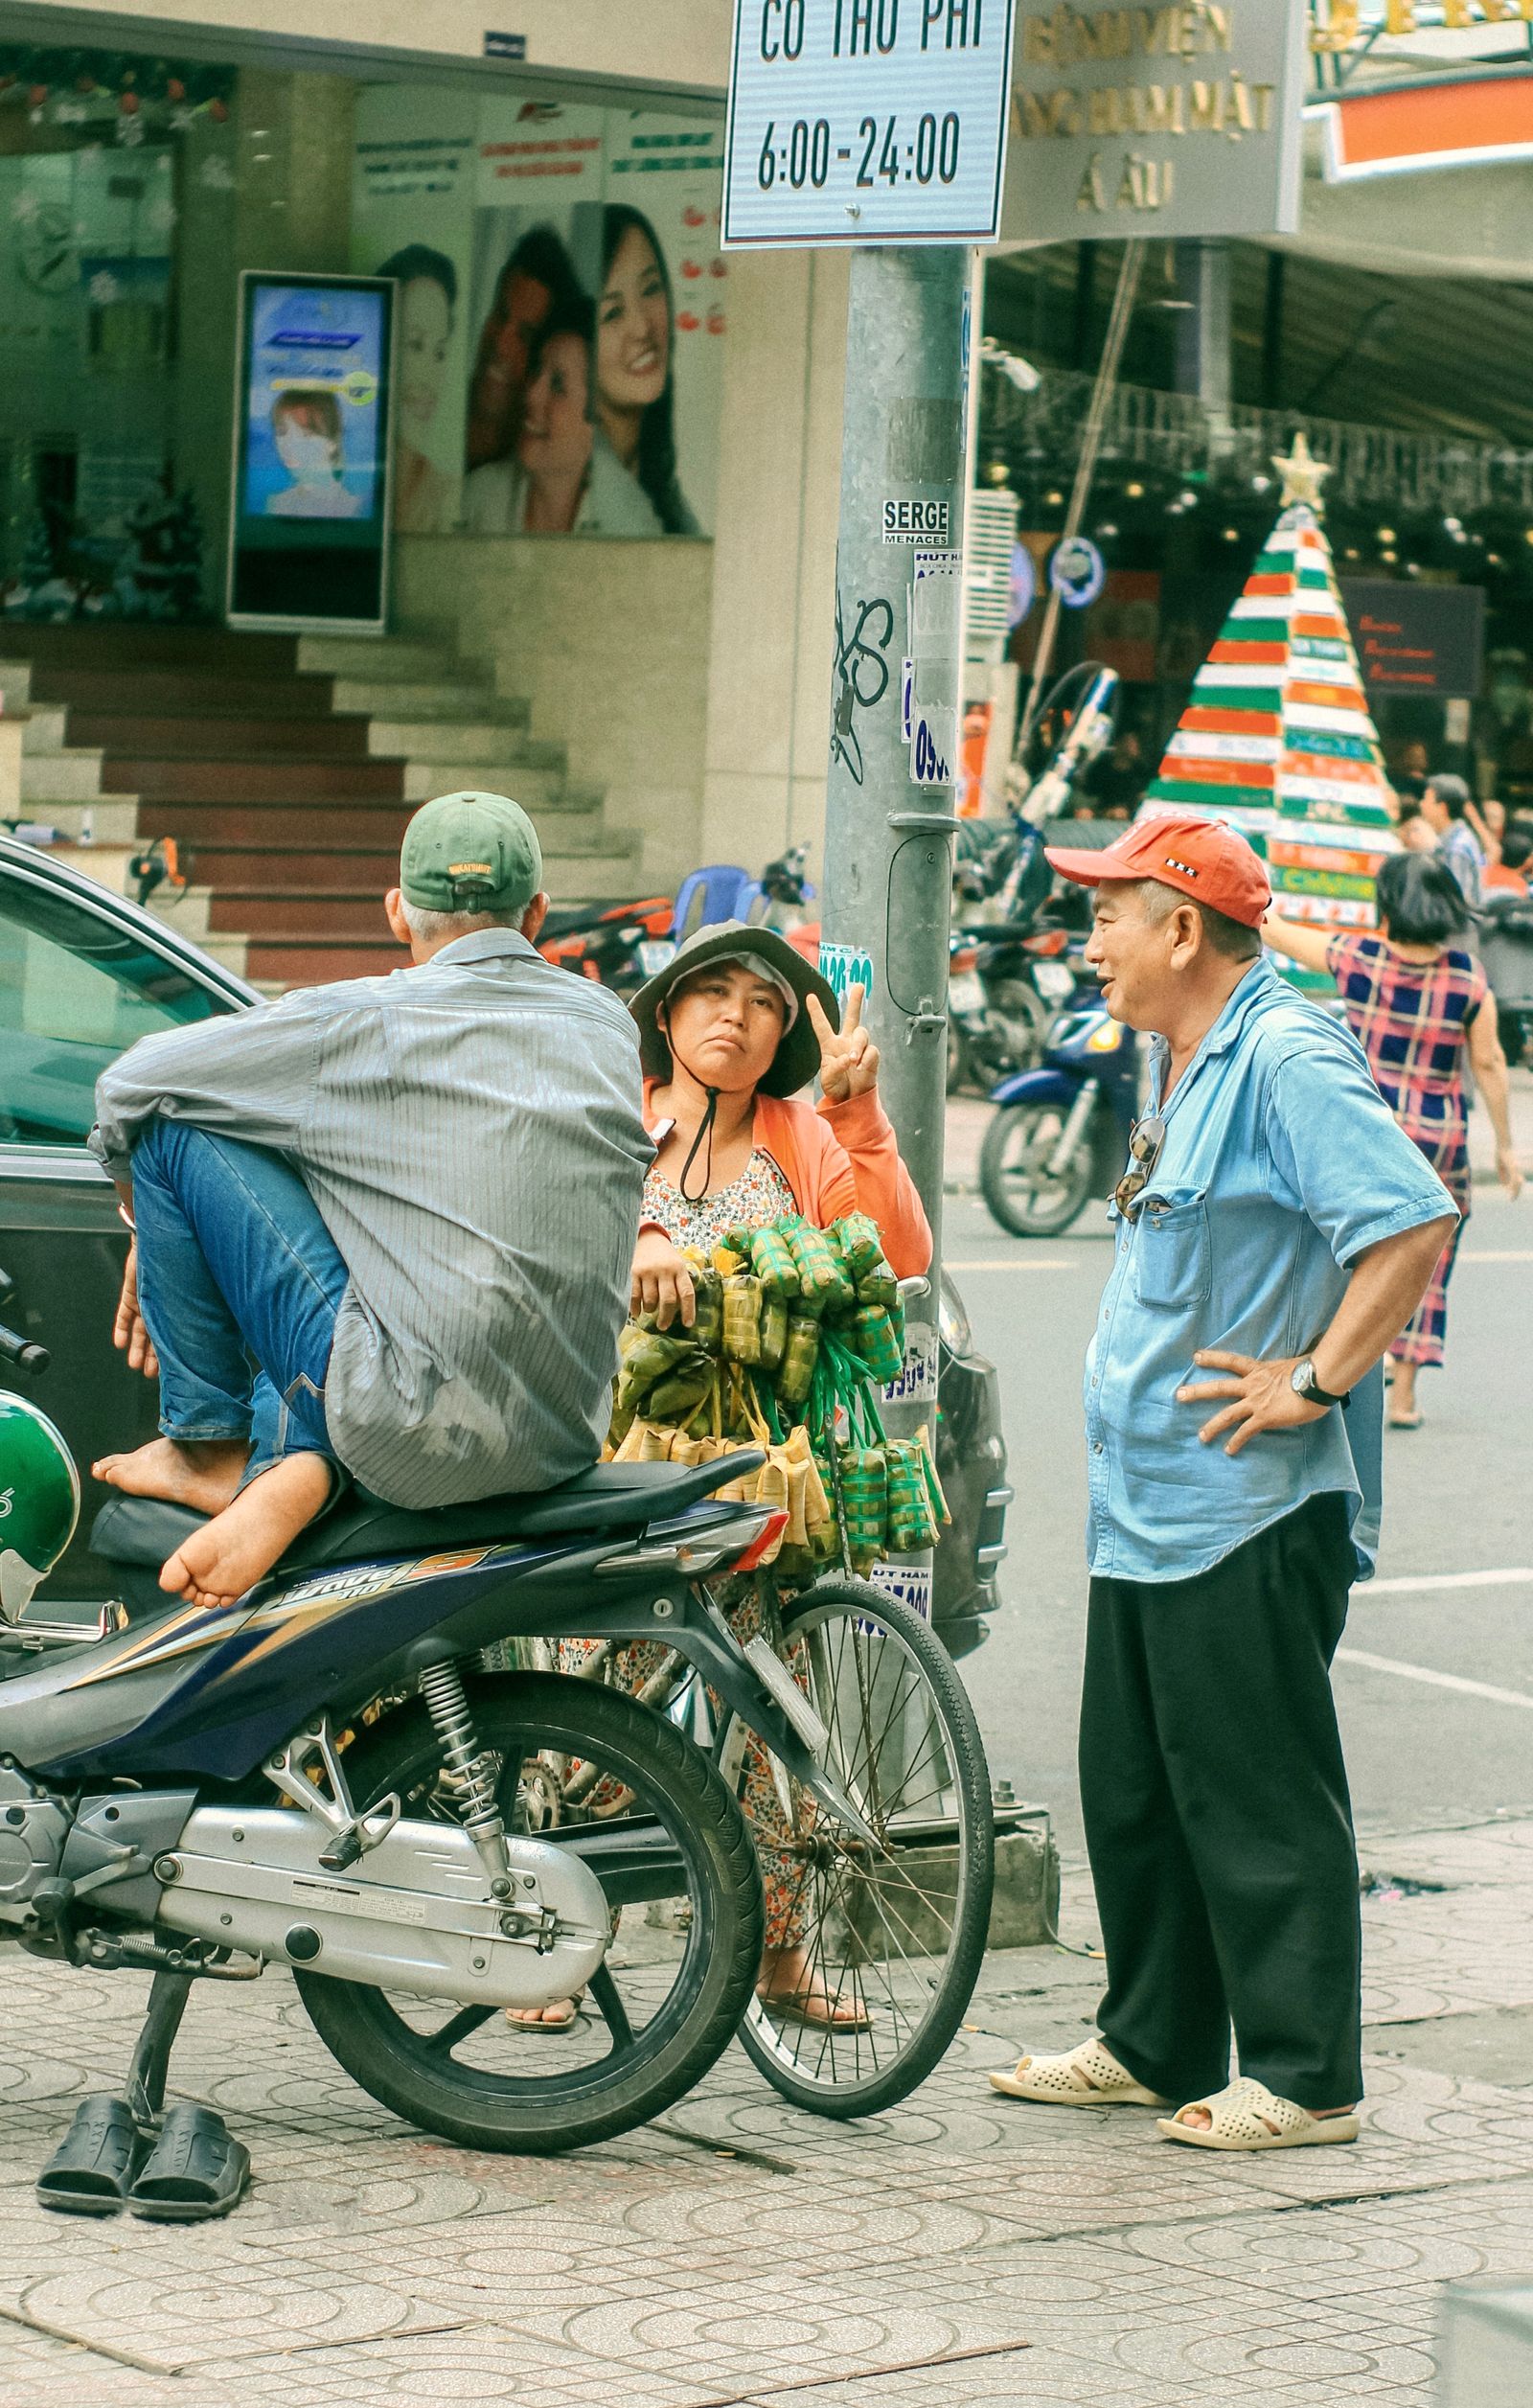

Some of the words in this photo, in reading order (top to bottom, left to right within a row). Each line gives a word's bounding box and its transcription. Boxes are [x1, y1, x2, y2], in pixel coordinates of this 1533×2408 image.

[884, 501, 948, 530] SERGE
[884, 535, 947, 544] MENACES
[337, 1580, 385, 1602] 110
